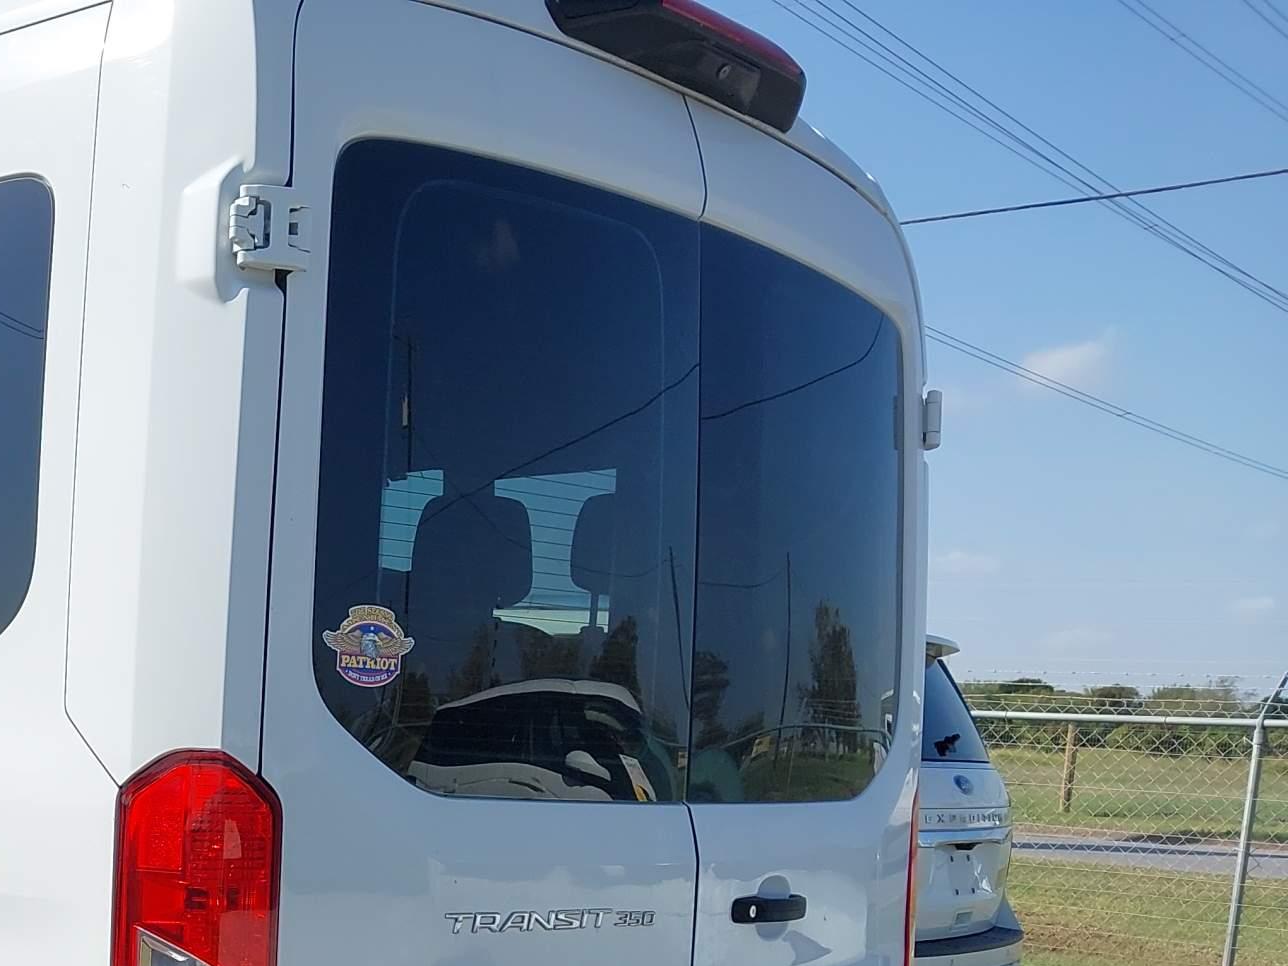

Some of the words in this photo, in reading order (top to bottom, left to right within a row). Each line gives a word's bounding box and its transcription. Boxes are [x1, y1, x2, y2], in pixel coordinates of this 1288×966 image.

[340, 654, 397, 671] PATRIOT
[444, 907, 613, 934] TRANSIT
[614, 910, 657, 928] 350
